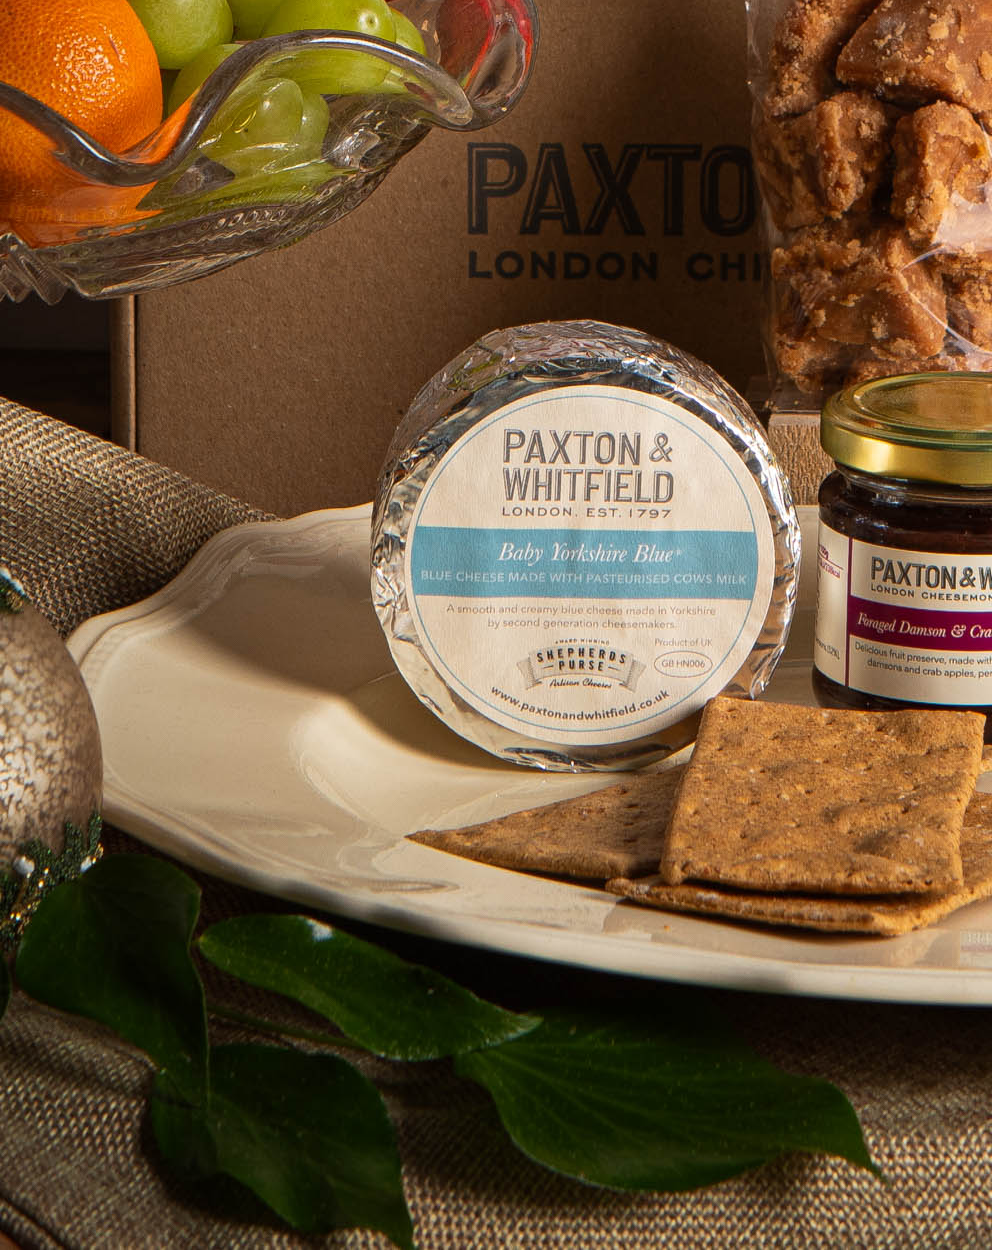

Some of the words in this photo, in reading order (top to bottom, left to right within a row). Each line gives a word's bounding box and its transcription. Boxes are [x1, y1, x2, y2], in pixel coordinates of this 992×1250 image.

[467, 142, 756, 237] PAXTO
[469, 251, 658, 281] LONDON
[503, 429, 641, 465] PAXTON
[649, 432, 673, 463] &
[503, 468, 675, 504] WHITFIELD
[502, 507, 578, 518] LONDON.
[586, 508, 621, 518] EST.
[629, 509, 672, 519] 1797
[497, 542, 544, 566] Baby
[552, 543, 628, 563] Yorkshire
[421, 570, 452, 581] BLUE
[456, 571, 505, 582] CHEESE
[508, 572, 546, 583] MADE
[549, 573, 583, 584] WITH
[586, 573, 670, 585] PASTEURISED
[673, 573, 712, 585] COWS
[716, 574, 747, 585] MILK
[870, 583, 915, 598] LONDON
[446, 605, 455, 614] A
[457, 605, 496, 614] smooth
[499, 605, 518, 614] and
[520, 607, 558, 617] creamy
[561, 605, 583, 615] blue
[586, 605, 623, 615] cheese
[626, 605, 655, 615] made
[658, 605, 667, 615] in
[670, 605, 716, 615] Yorkshire
[487, 618, 500, 630] by
[503, 618, 540, 629] second
[543, 619, 599, 631] generation
[857, 611, 896, 634] Foraged
[899, 619, 947, 638] Damson
[950, 624, 967, 638] &
[654, 637, 688, 647] Product
[689, 637, 699, 647] of
[700, 637, 713, 647] UK
[536, 647, 626, 664] SHEPHERDS
[855, 641, 888, 657] Delicious
[889, 648, 905, 661] fruit
[906, 652, 947, 666] preserve,
[949, 655, 974, 665] made
[558, 659, 604, 671] PURSE
[867, 658, 903, 672] damsons
[904, 664, 920, 675] and
[922, 666, 942, 676] crab
[944, 667, 976, 679] apples,
[490, 684, 670, 722] www.paxtonandwhitfield.co.uk
